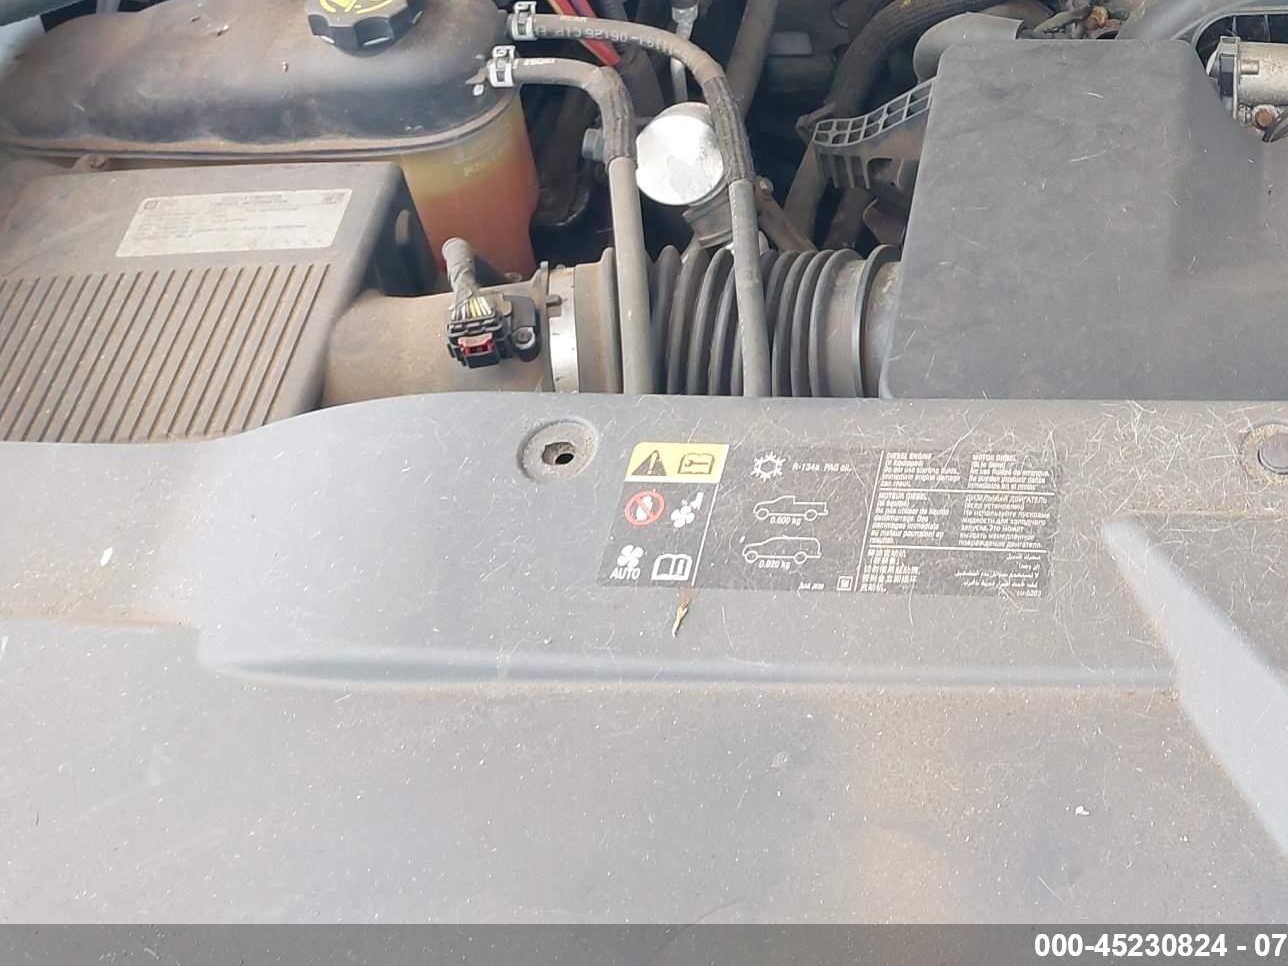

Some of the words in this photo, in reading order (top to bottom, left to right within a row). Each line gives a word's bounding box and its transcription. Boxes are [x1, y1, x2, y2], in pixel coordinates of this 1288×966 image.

[792, 517, 802, 526] kg
[781, 561, 792, 570] kg
[608, 568, 641, 580] AUTO
